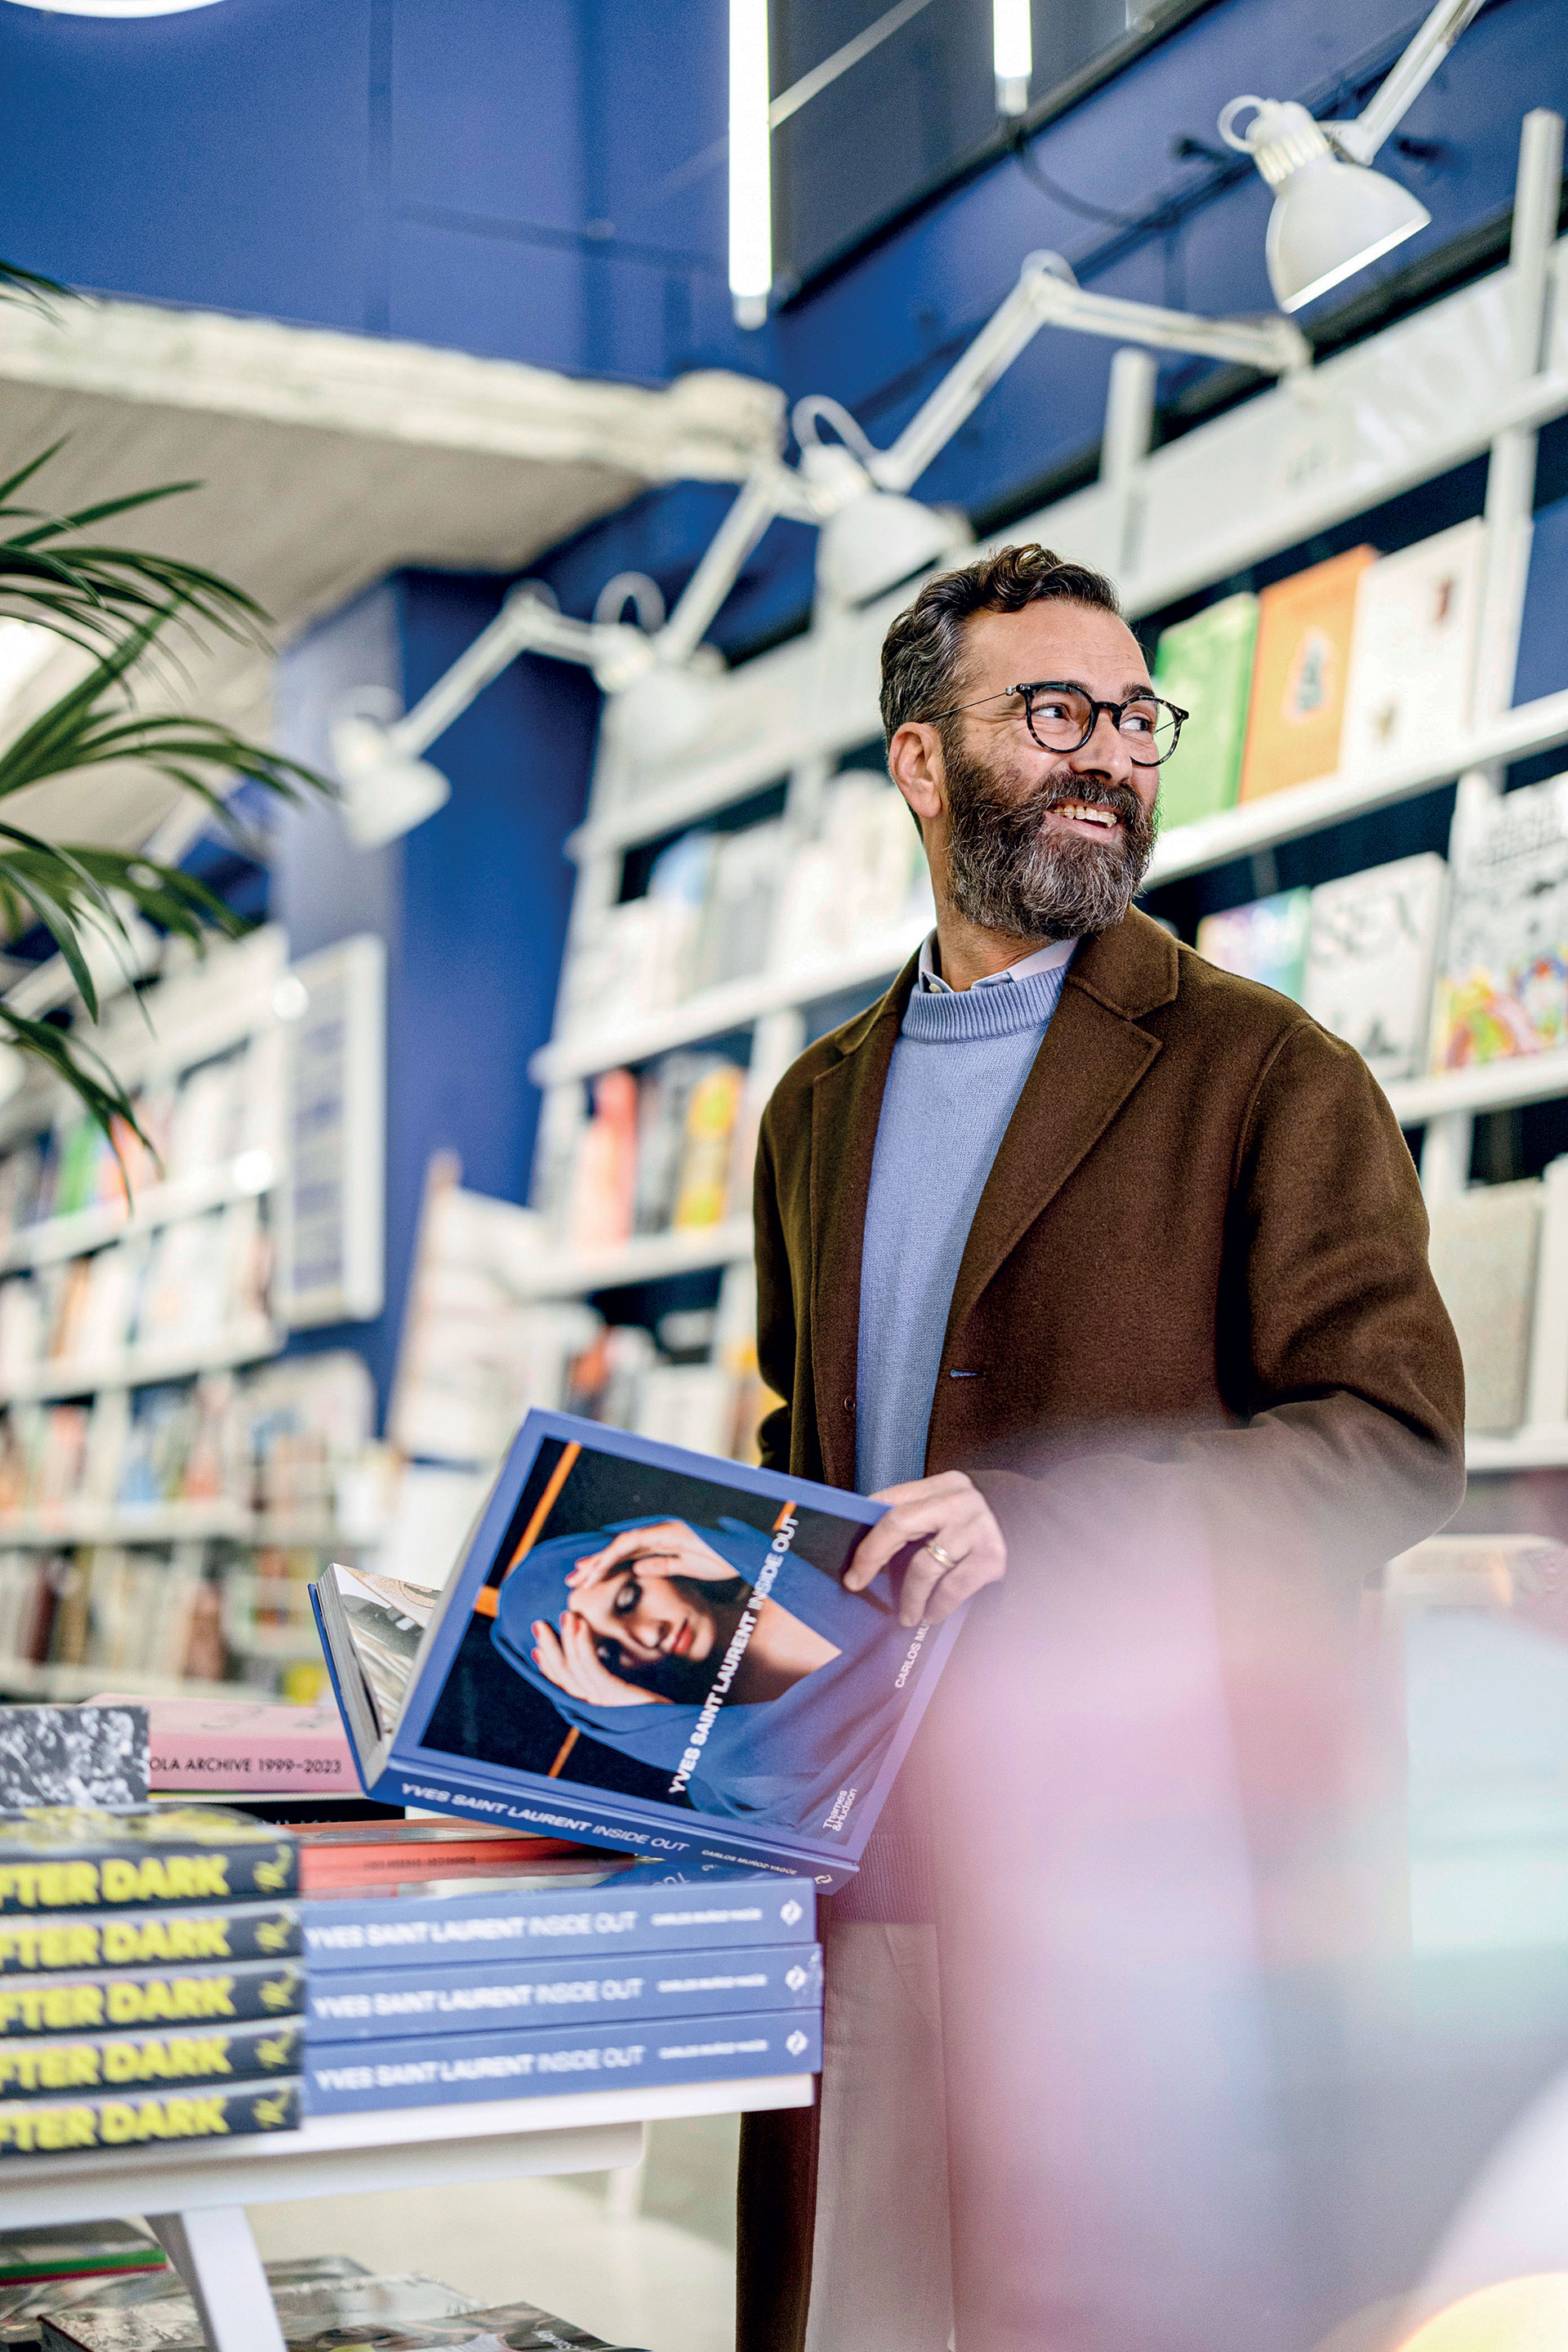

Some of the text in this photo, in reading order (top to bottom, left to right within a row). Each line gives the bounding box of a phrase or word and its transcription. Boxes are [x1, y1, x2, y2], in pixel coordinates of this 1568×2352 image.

[669, 1513, 800, 1793] YVES SAINT LAURENT INSIDE OUT
[894, 1642, 922, 1688] CARLOS
[185, 1757, 252, 1773] ARCHIVE
[402, 1783, 690, 1852] YVES SAINT LAURENT INSIDE OUT
[822, 1789, 848, 1829] Thames
[832, 1788, 858, 1831] &Hudson
[100, 1854, 230, 1903] DARK
[701, 1849, 737, 1862] CARLOS
[101, 1916, 232, 1964] DARK
[305, 1924, 364, 1949] YVES
[365, 1921, 429, 1947] SAINT
[430, 1916, 525, 1944] LAURENT
[595, 1911, 639, 1933] OUT
[105, 1976, 237, 2024] DARK
[311, 1993, 372, 2019] YVES
[373, 1989, 436, 2016] SAINT
[437, 1984, 533, 2011] LAURENT
[601, 1977, 645, 2000] OUT
[102, 2034, 233, 2082] DARK
[314, 2065, 374, 2091] YVES
[376, 2060, 439, 2087] SAINT
[439, 2054, 535, 2082] LAURENT
[602, 2045, 646, 2068] OUT
[100, 2095, 230, 2144] DARK
